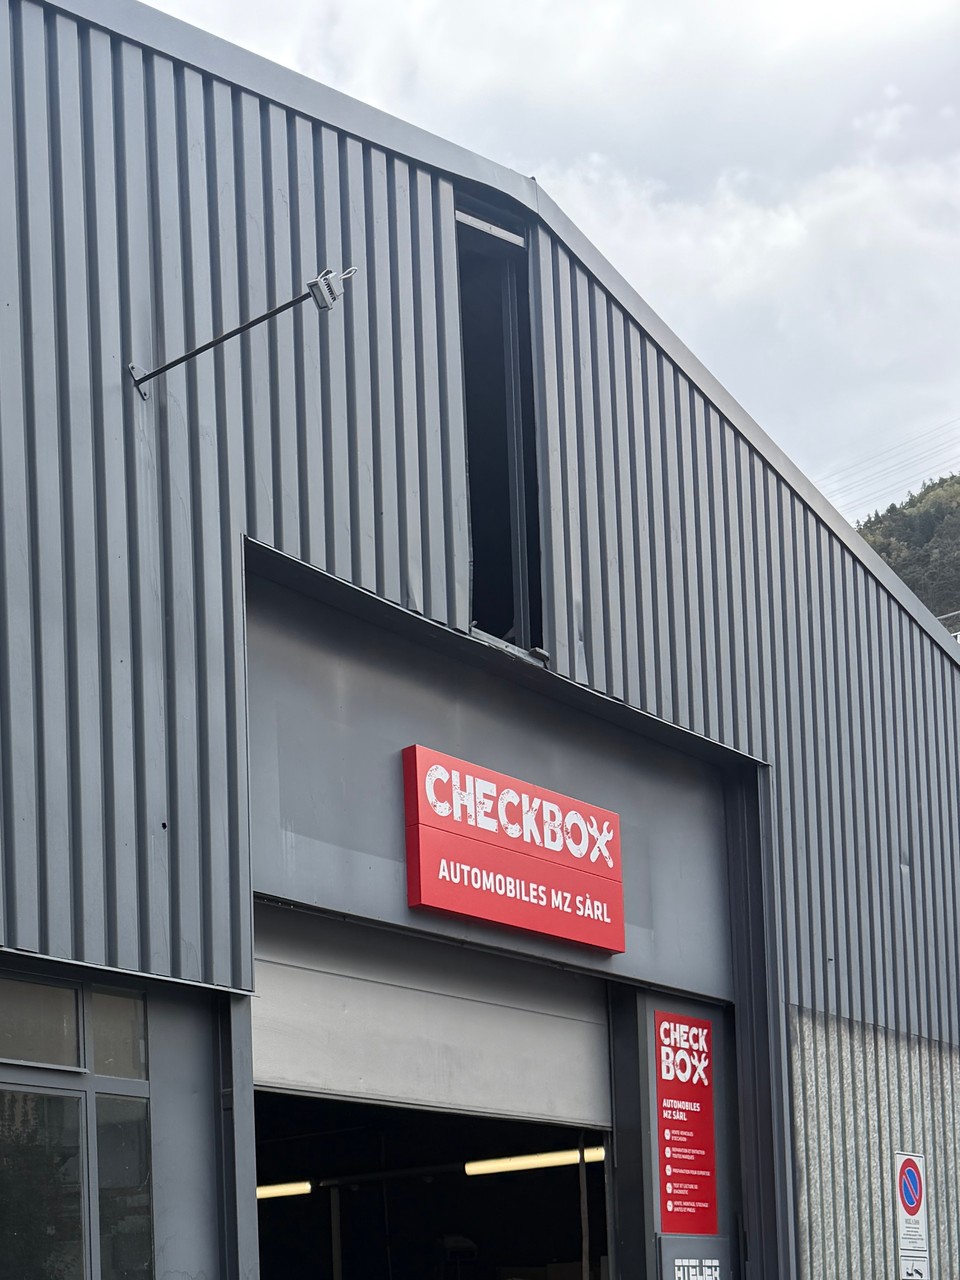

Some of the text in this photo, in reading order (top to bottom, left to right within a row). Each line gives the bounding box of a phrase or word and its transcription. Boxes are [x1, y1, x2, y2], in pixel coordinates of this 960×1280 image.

[425, 764, 614, 868] CHECKBOX
[438, 859, 611, 923] AUTOMOBILES MZ SÀRL
[659, 1020, 708, 1053] CHECK
[660, 1046, 709, 1086] BOX
[662, 1098, 700, 1112] AUTOMOBILES
[662, 1109, 672, 1119] MZ
